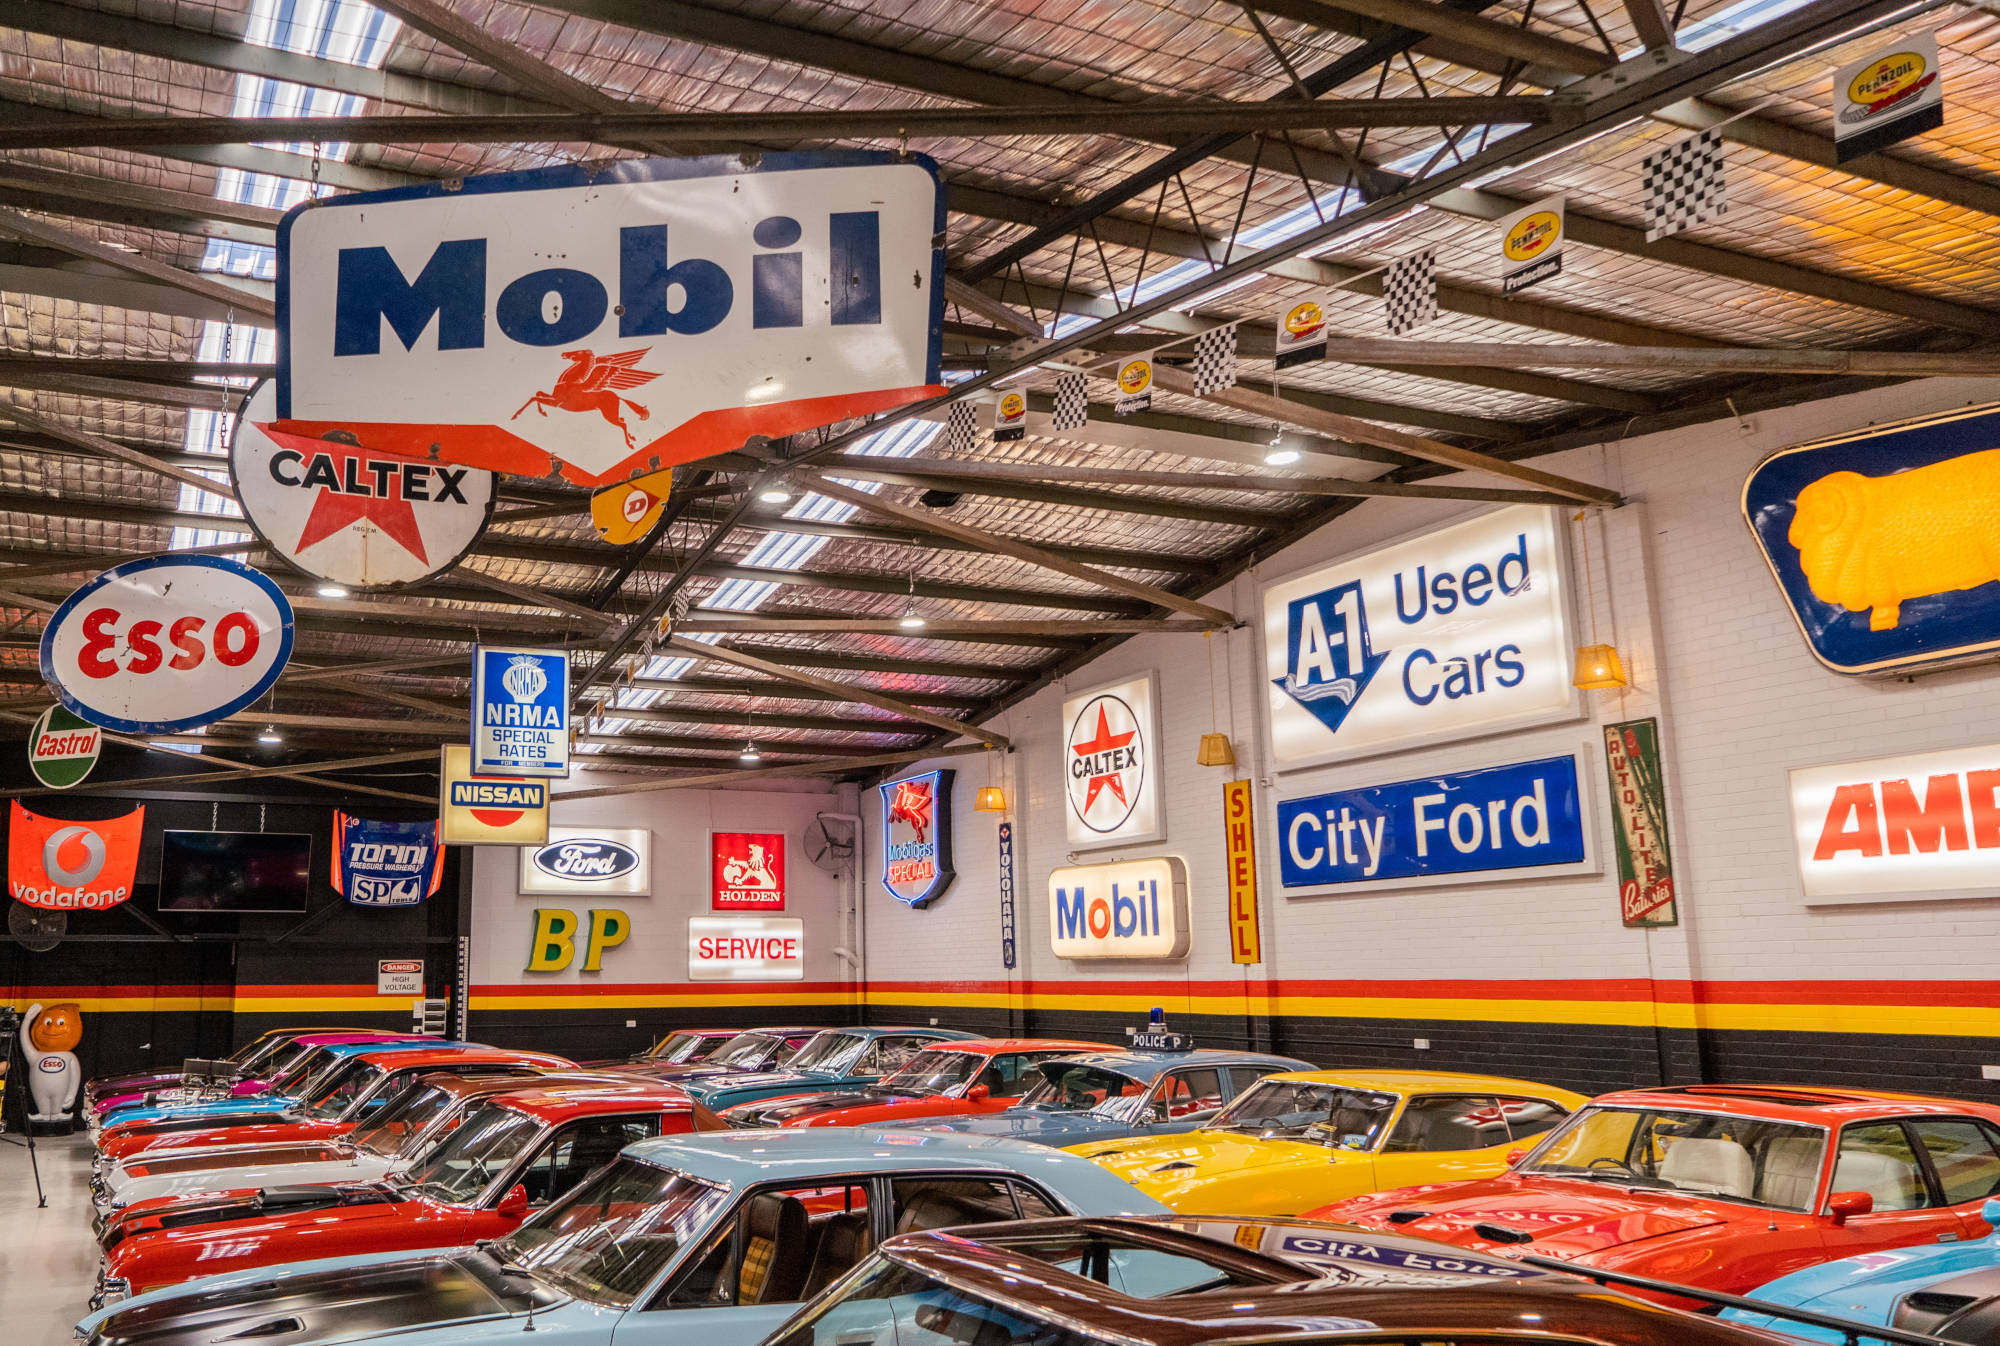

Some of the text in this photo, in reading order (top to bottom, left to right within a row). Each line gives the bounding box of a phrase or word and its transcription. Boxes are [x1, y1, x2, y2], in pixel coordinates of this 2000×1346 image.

[1857, 61, 1914, 96] PENNZOIL
[334, 211, 881, 356] Mobil
[269, 450, 469, 505] CALTEX
[627, 498, 647, 516] D
[1394, 533, 1532, 625] Used
[1295, 589, 1364, 687] A-1
[1402, 643, 1525, 706] Cars
[487, 703, 560, 728] NRMA
[37, 731, 98, 757] Castrol
[492, 729, 555, 744] SPECIAL
[500, 744, 546, 758] RATES
[1071, 746, 1137, 779] CALTEX
[455, 785, 540, 804] NISSAN
[1288, 778, 1551, 877] City Ford
[349, 861, 417, 872] PRESSURE WASHERS
[350, 843, 428, 865] TORINI
[554, 844, 617, 874] Ford
[888, 862, 934, 884] SPECIAL
[1231, 788, 1252, 956] SHELL
[13, 881, 127, 907] vodafone
[355, 880, 390, 903] SP
[719, 890, 780, 902] HOLDEN
[1000, 841, 1013, 940] YOKOHAMA
[1056, 880, 1160, 939] Mobil
[524, 909, 631, 972] BP
[699, 937, 797, 960] SERVICE
[387, 963, 415, 972] DANGER
[1133, 1034, 1166, 1047] POLICE
